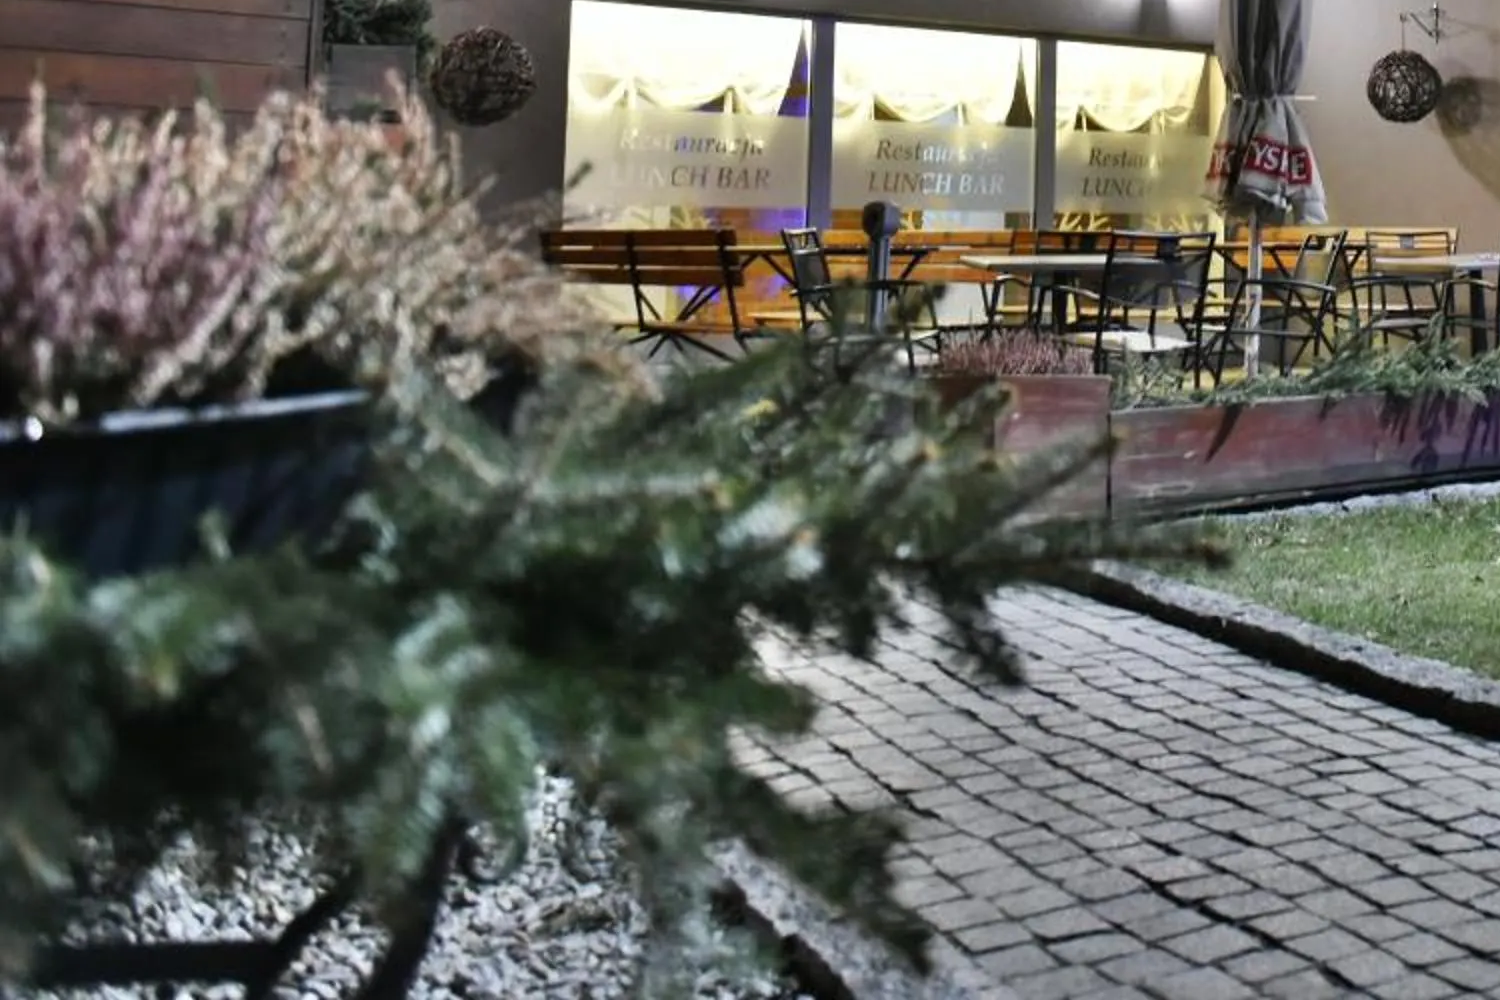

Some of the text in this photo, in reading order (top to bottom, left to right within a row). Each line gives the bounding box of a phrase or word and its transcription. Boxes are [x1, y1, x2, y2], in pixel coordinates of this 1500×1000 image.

[717, 165, 774, 191] BAR
[867, 168, 1006, 196] LUNCH BAR
